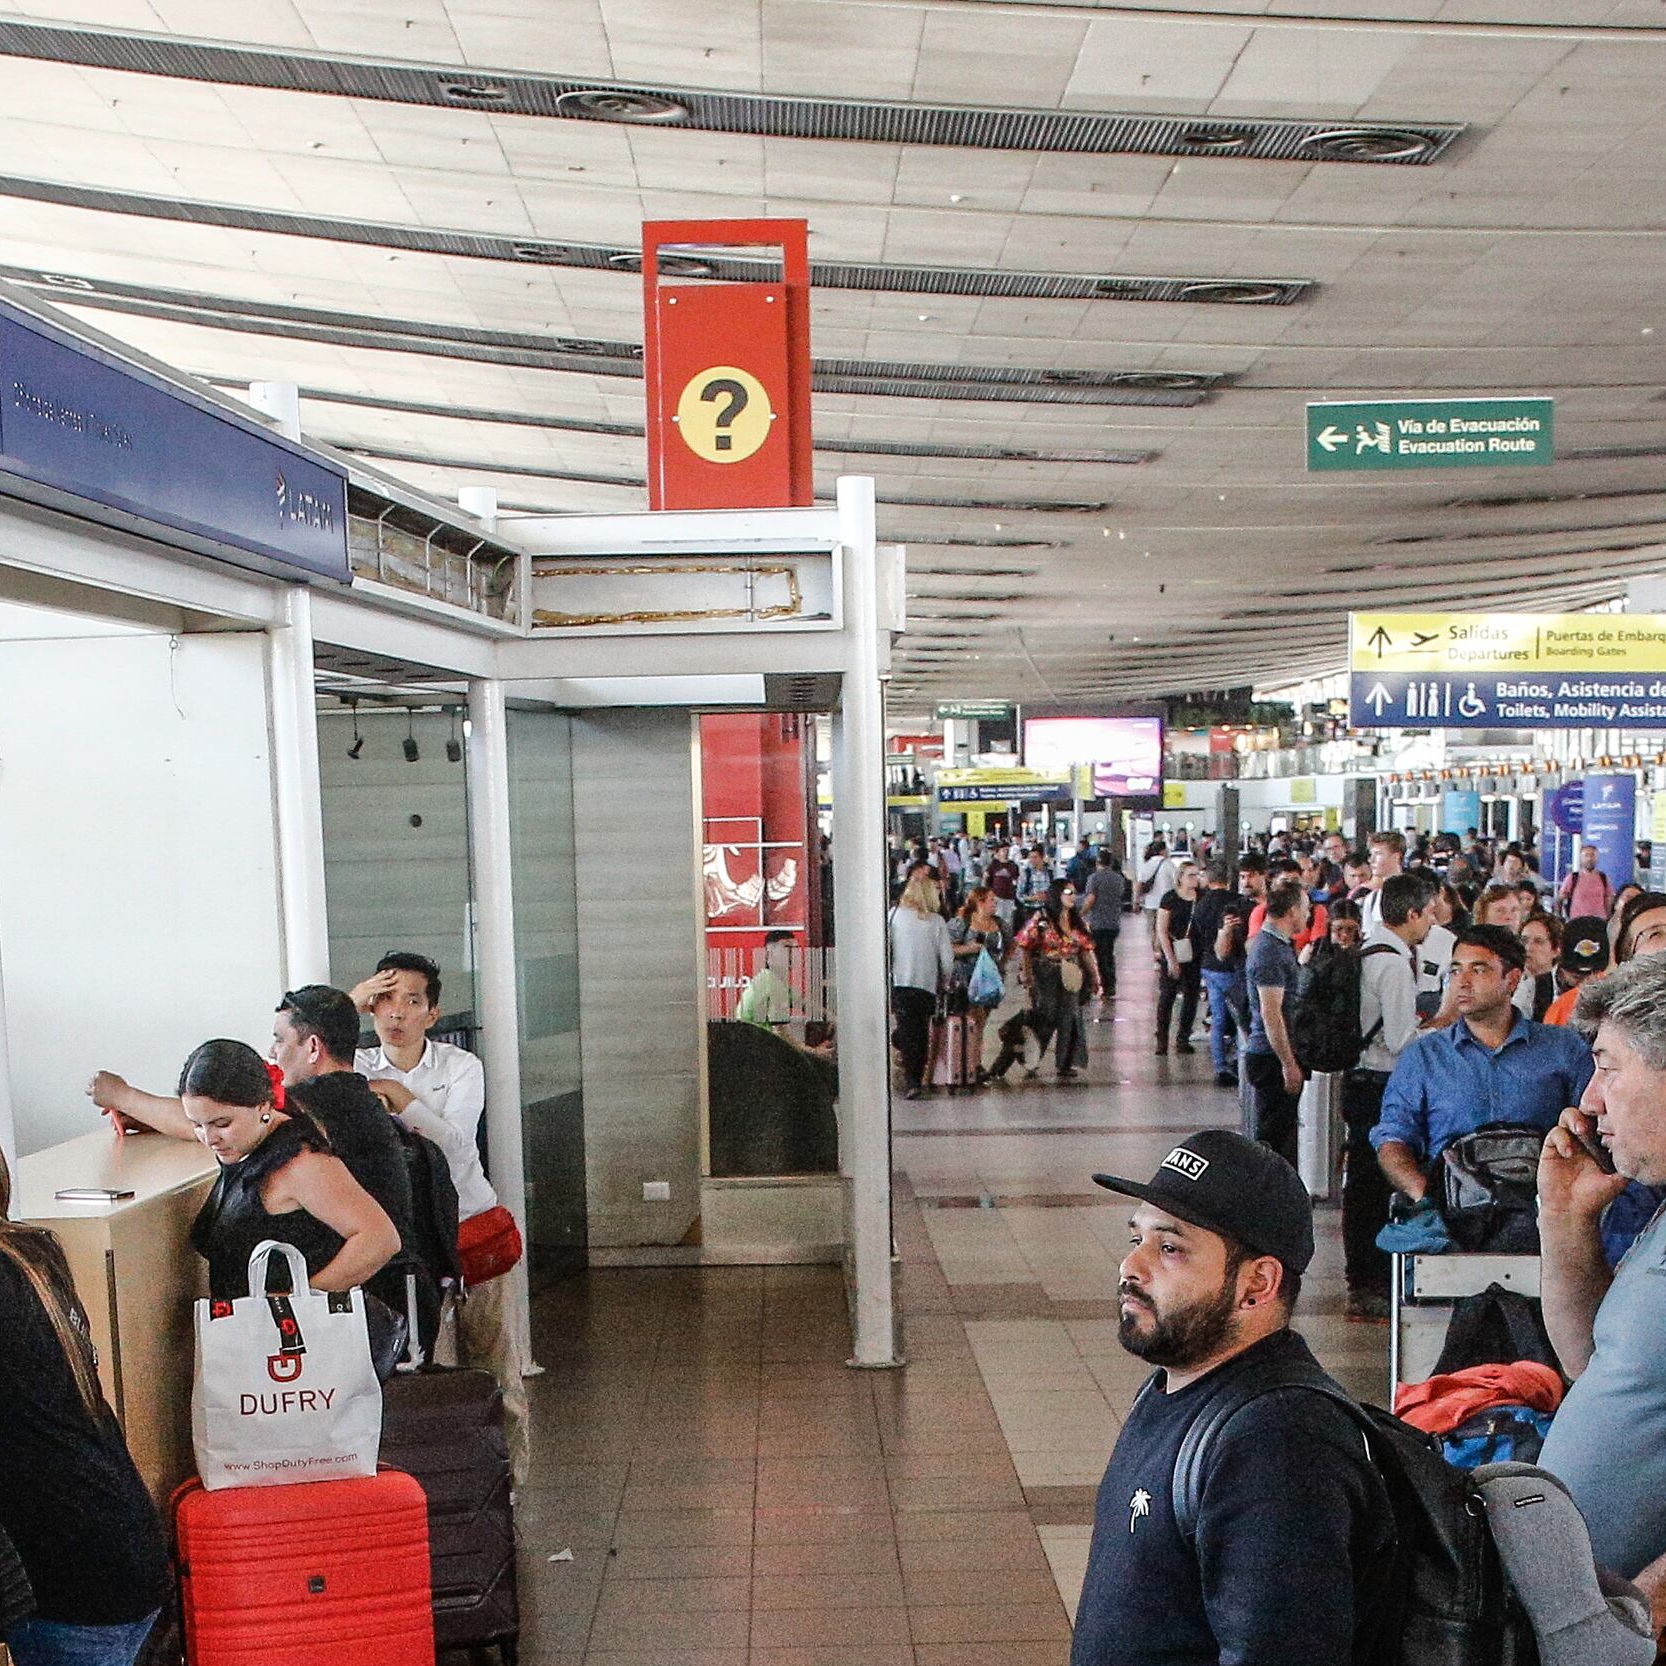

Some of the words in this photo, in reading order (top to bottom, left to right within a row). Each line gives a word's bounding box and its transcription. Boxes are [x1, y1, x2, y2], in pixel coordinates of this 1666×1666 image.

[1397, 418, 1425, 434] Vía
[1425, 417, 1446, 433] de
[1449, 415, 1540, 433] Evacuación
[1398, 438, 1486, 455] Evacuation
[1488, 436, 1536, 452] Route
[1449, 624, 1509, 641] Salidas
[1545, 630, 1594, 643] Puertas
[1598, 629, 1614, 642] de
[1448, 646, 1529, 662] Departures
[1496, 680, 1553, 701] Baños,
[1558, 682, 1645, 699] Asistencia
[1496, 702, 1550, 720] Toilets,
[1554, 702, 1616, 720] Mobility
[239, 1387, 336, 1417] DUFRY
